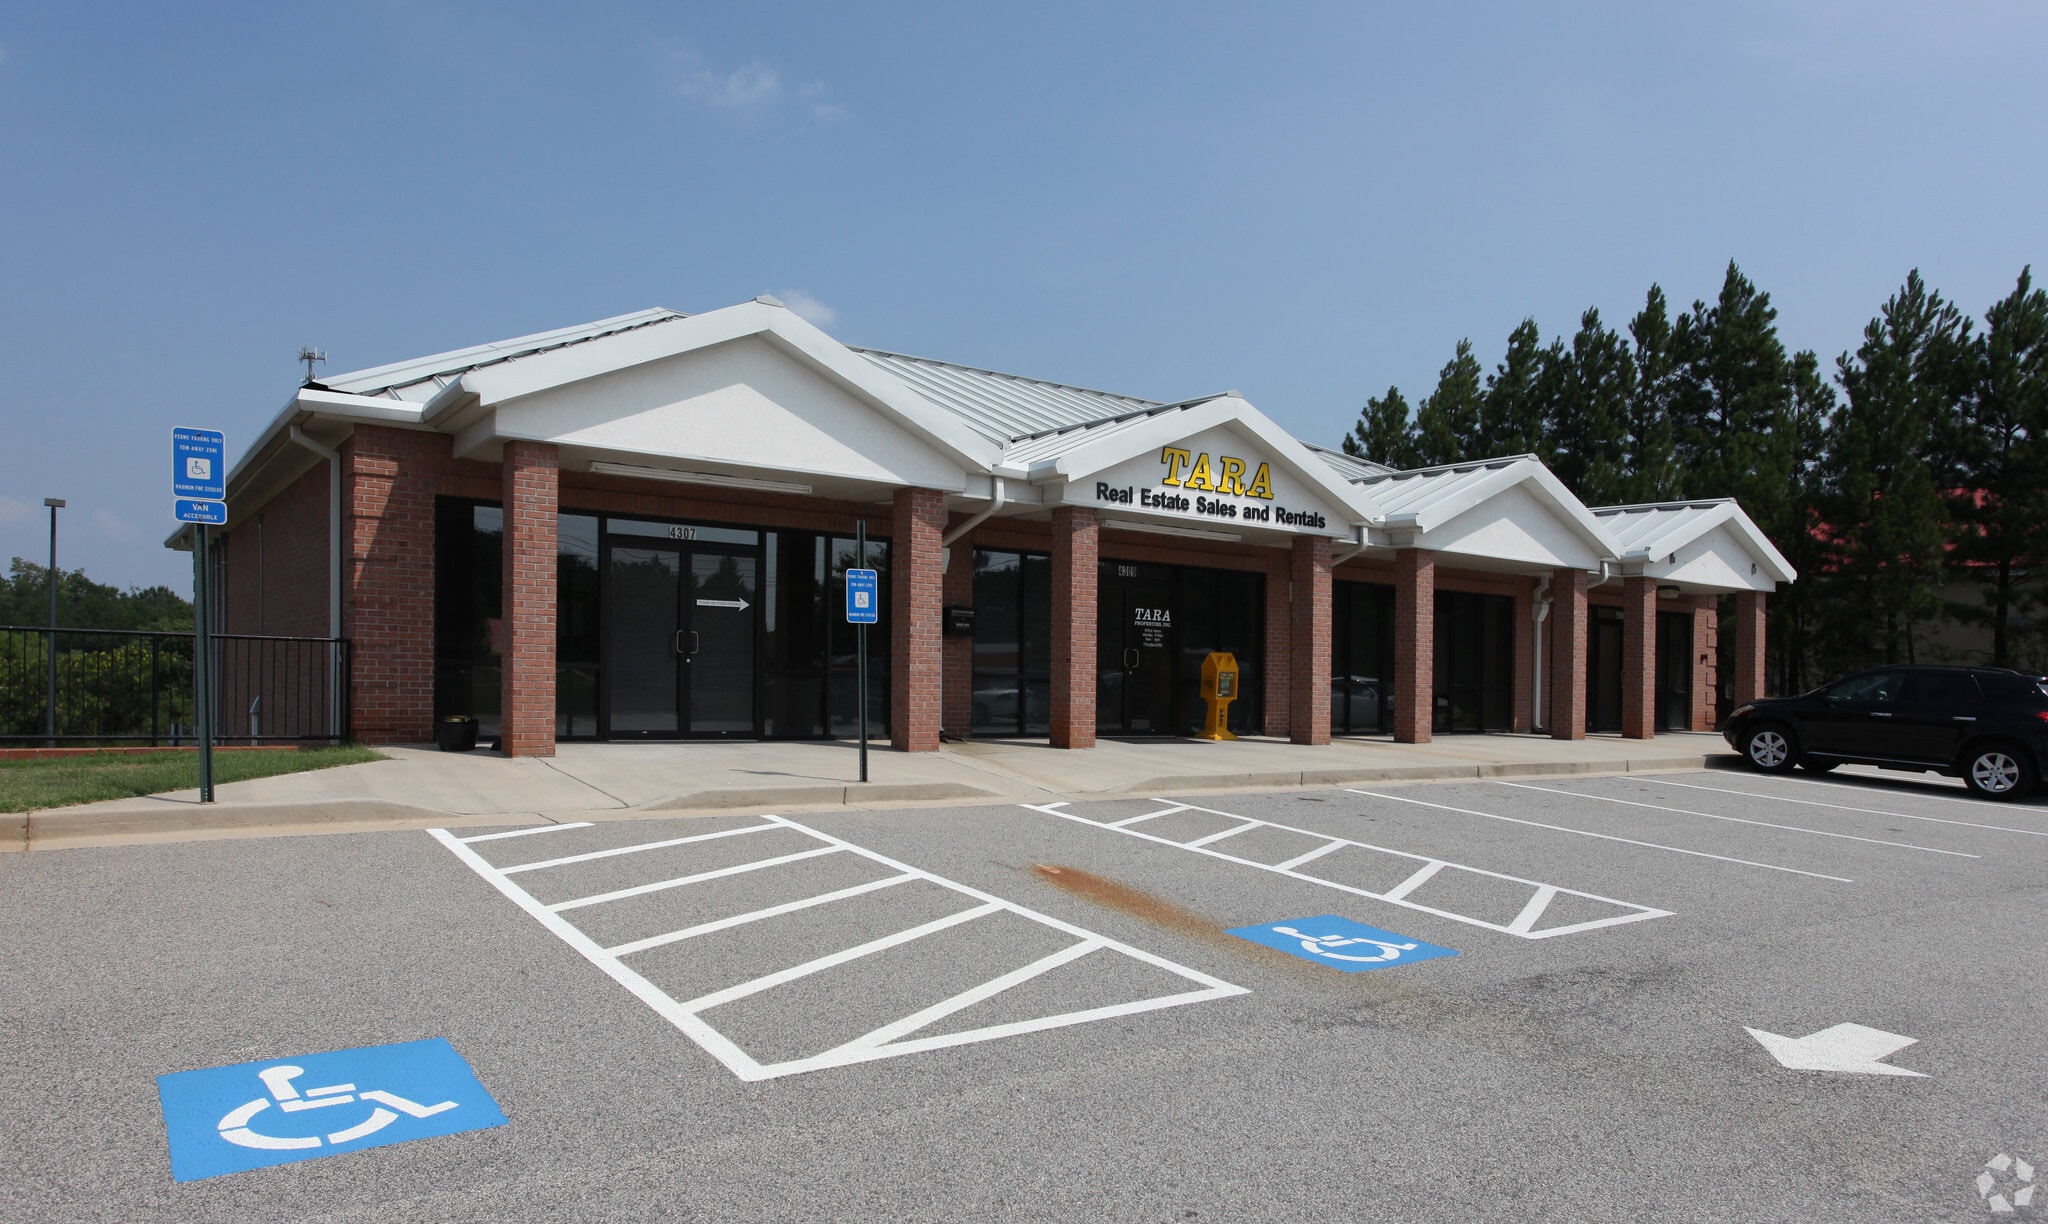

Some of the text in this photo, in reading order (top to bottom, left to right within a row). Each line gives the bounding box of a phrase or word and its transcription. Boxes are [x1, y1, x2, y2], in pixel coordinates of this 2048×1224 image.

[174, 433, 190, 441] PERMIT
[191, 435, 210, 443] PARKING
[179, 444, 204, 453] TOW-AWAY
[1161, 446, 1274, 500] TARA
[192, 503, 209, 512] VAN
[1096, 482, 1326, 529] Real Estate Sales and Rentals
[183, 512, 218, 521] ACCESSIBLE
[670, 526, 696, 540] 4307
[1118, 565, 1137, 577] 4309
[1134, 607, 1171, 622] TARA
